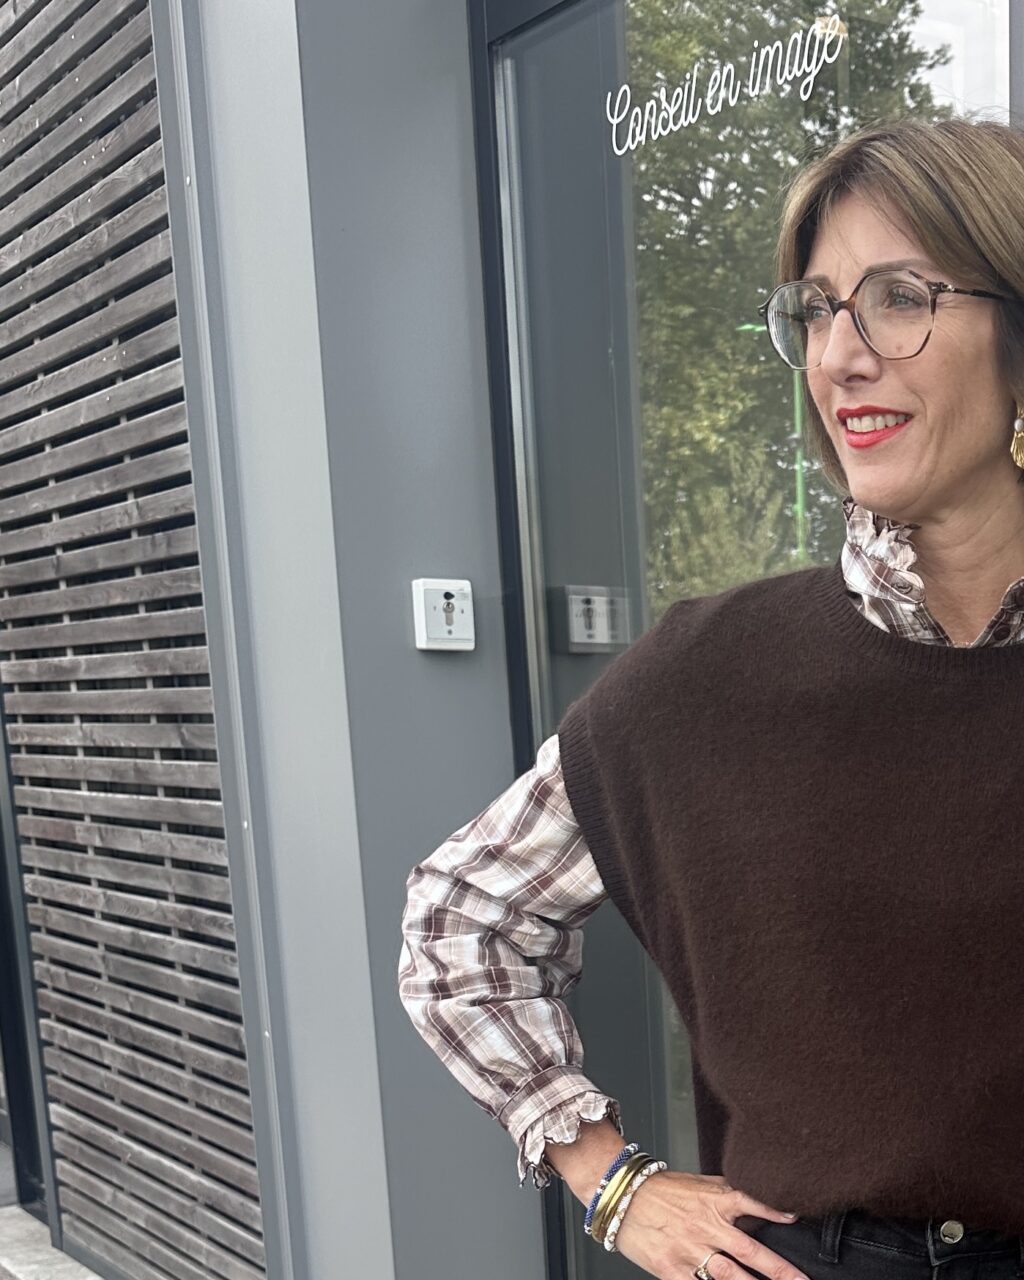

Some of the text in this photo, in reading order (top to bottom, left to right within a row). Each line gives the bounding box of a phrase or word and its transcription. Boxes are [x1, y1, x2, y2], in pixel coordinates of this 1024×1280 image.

[606, 13, 844, 156] Conseil en image
